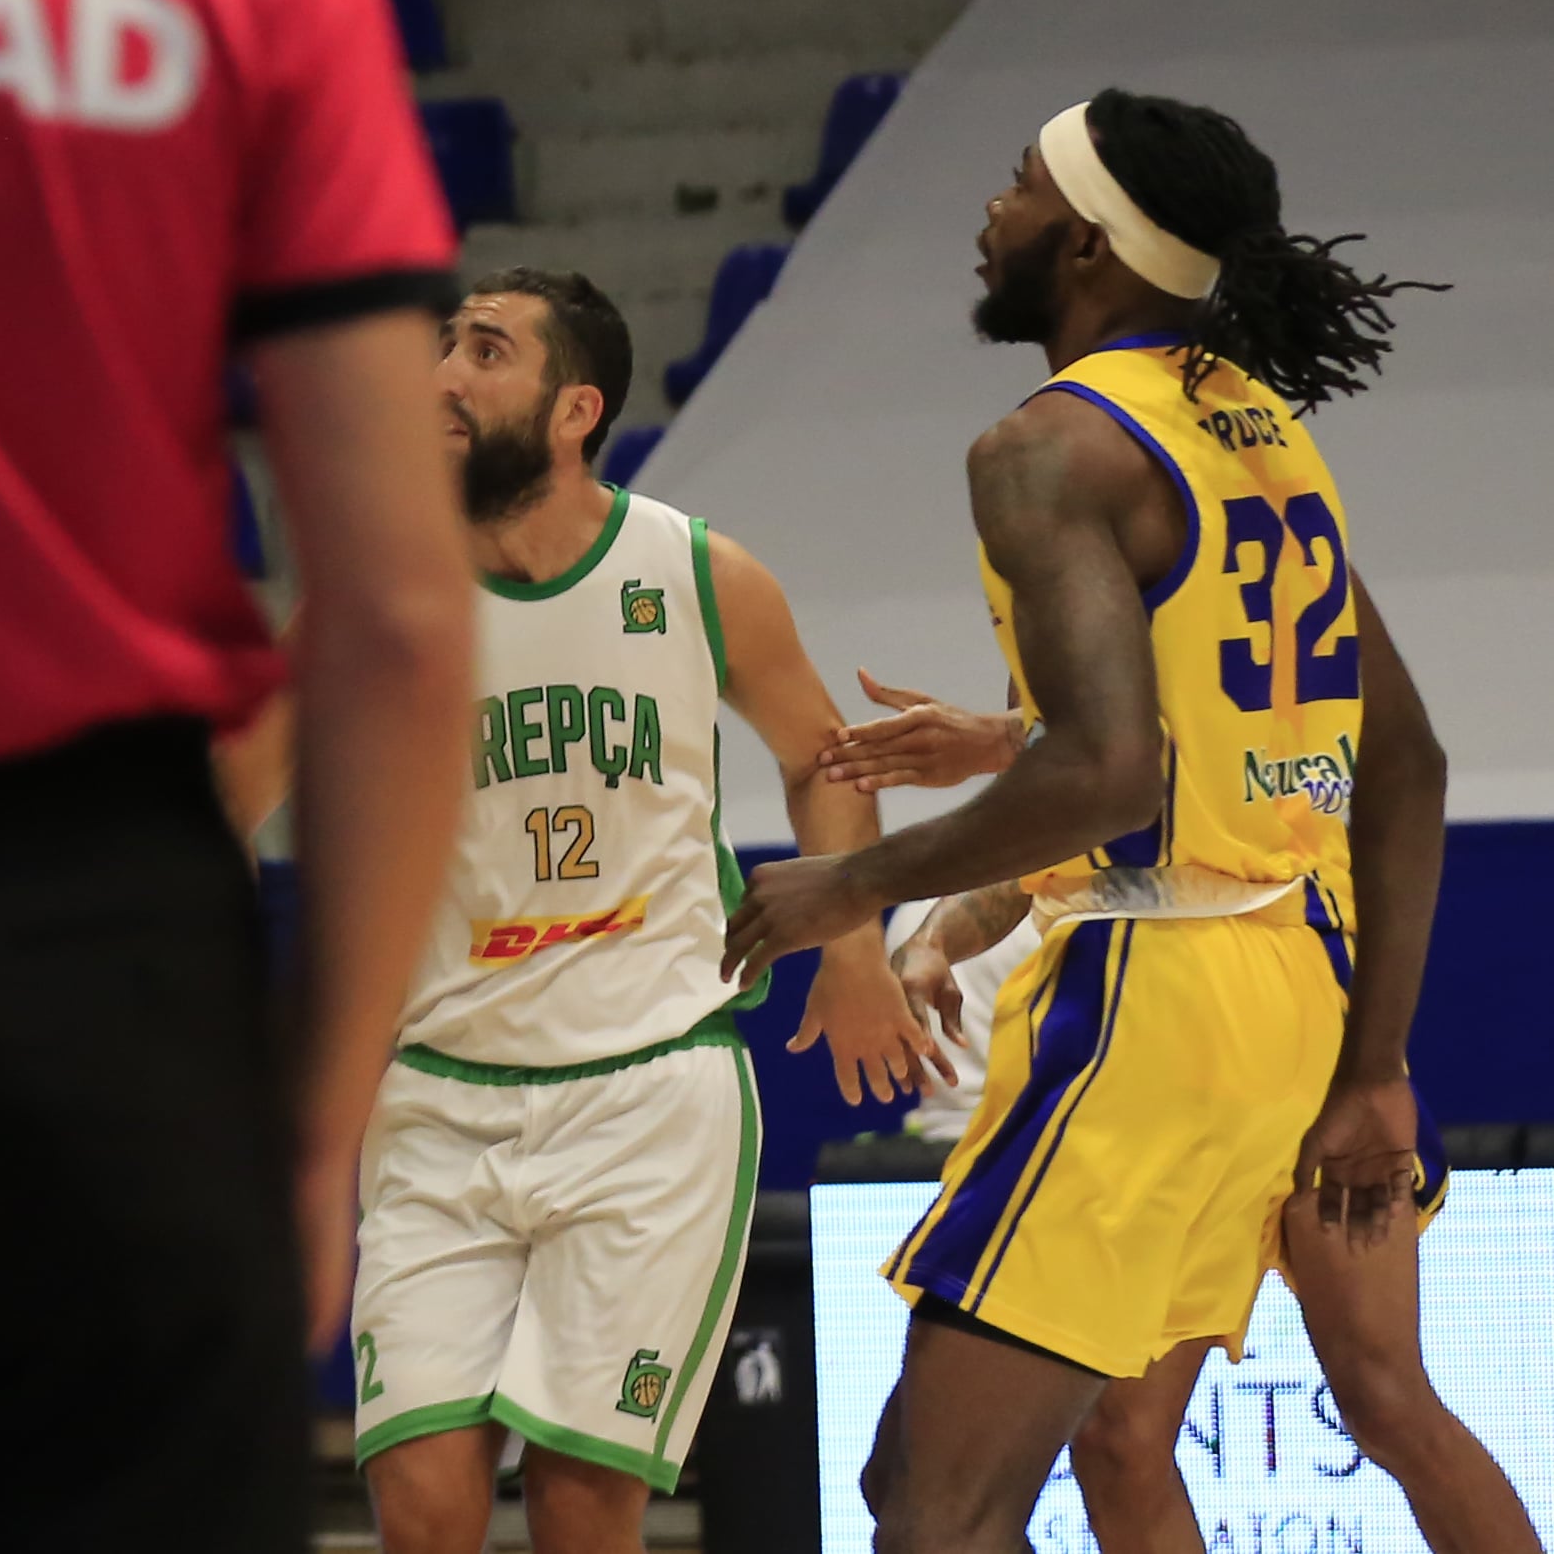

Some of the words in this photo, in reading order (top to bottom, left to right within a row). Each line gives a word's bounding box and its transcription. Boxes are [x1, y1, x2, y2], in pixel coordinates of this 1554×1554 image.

[1219, 490, 1361, 713] 32
[473, 683, 664, 790] REPÇA
[524, 804, 600, 882] 12
[356, 1330, 385, 1405] 2
